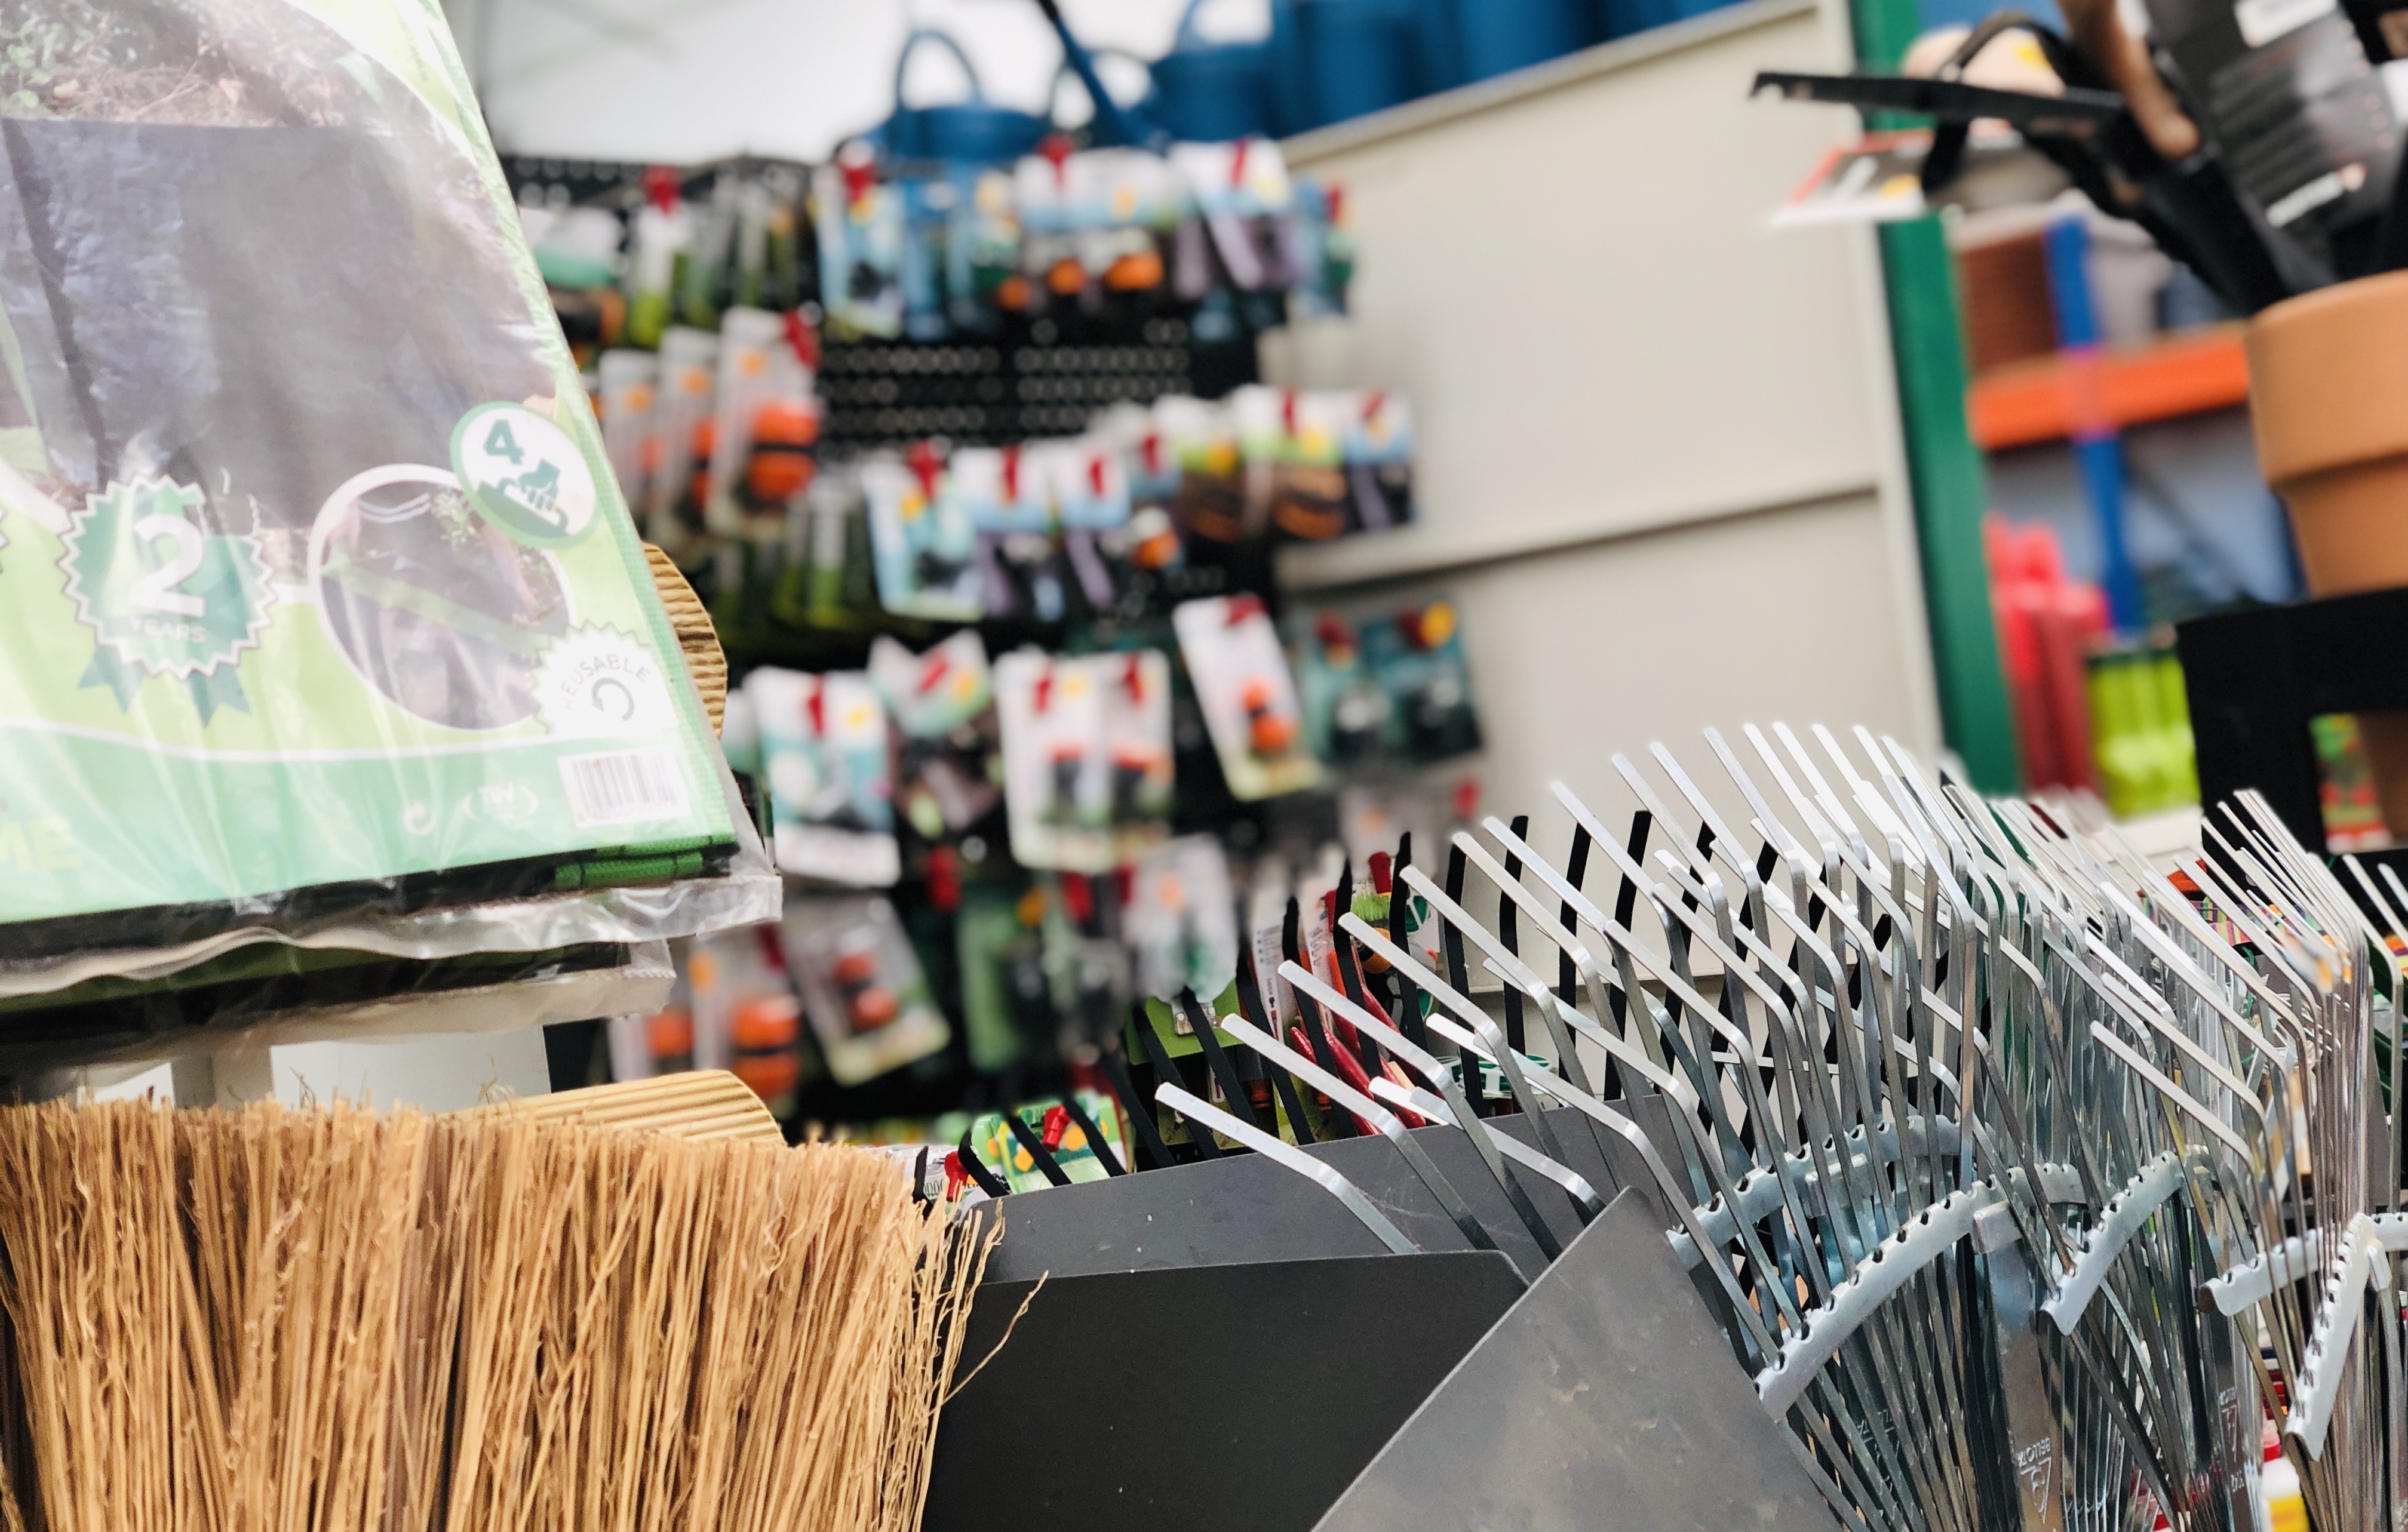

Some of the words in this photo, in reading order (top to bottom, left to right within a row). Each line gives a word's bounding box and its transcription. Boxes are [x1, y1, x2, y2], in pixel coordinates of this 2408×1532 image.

[483, 419, 525, 465] 4
[128, 515, 205, 617] 2
[128, 615, 207, 643] YEARS
[560, 654, 650, 710] REUSABLE
